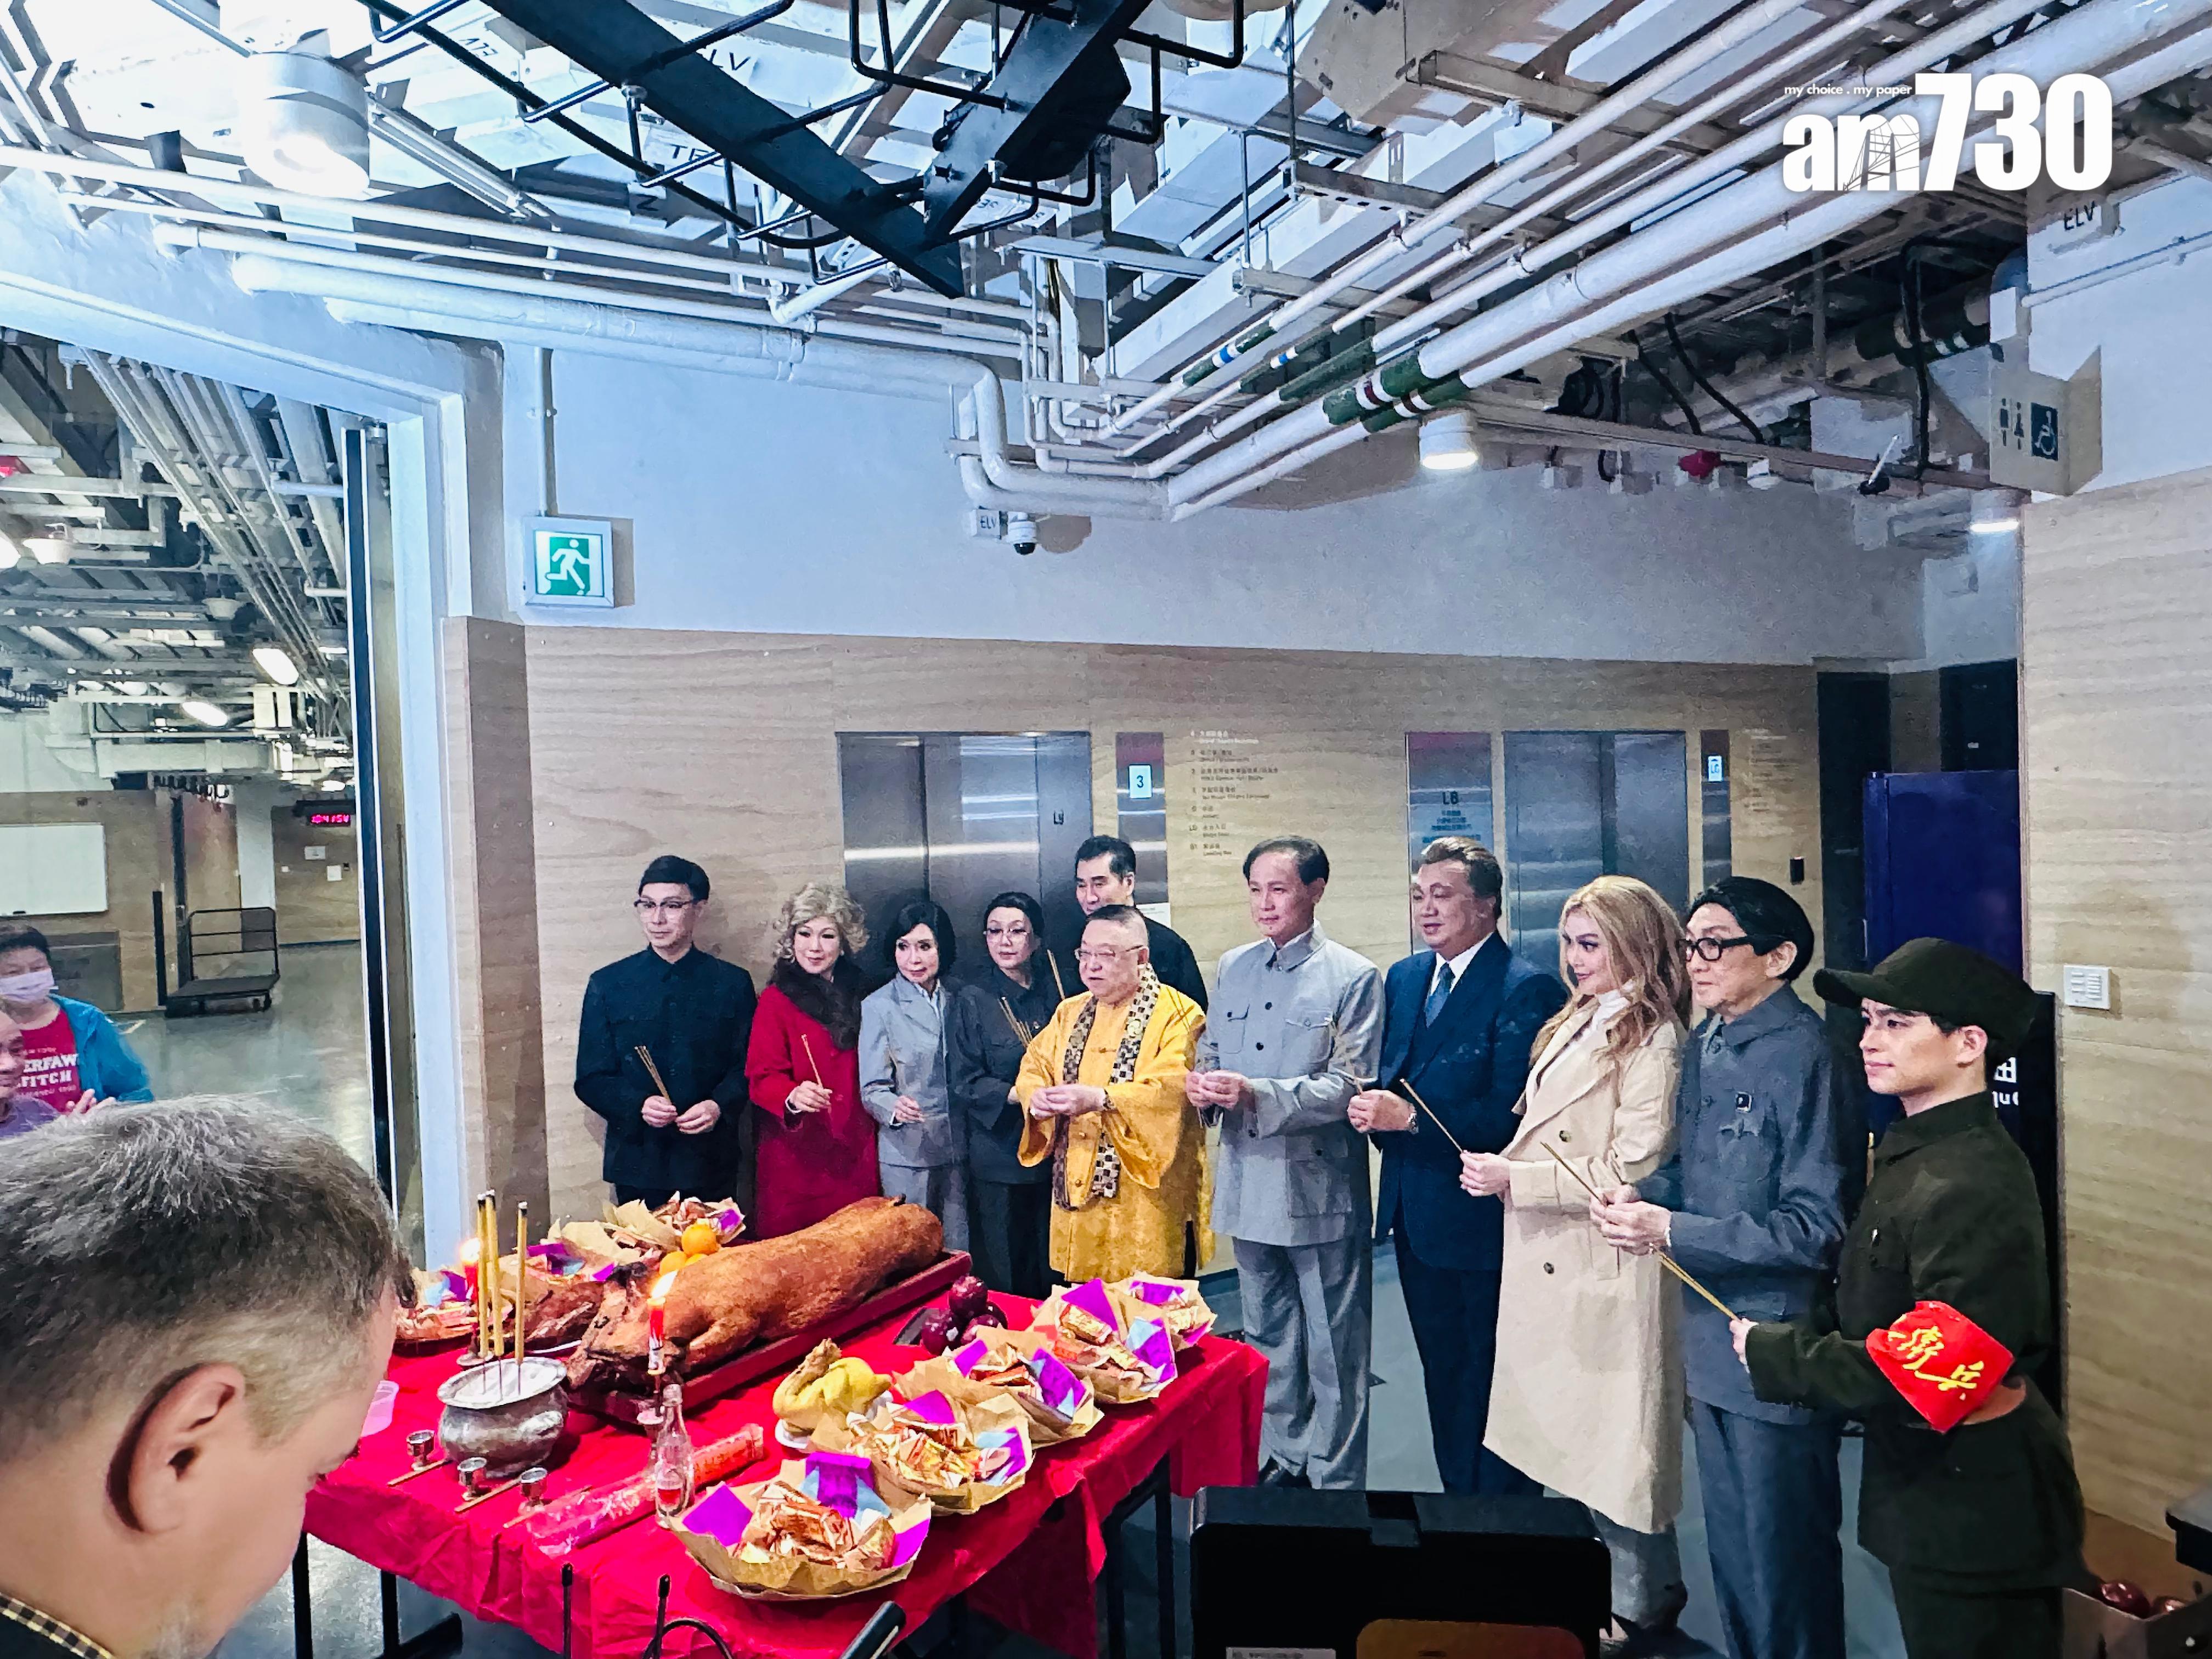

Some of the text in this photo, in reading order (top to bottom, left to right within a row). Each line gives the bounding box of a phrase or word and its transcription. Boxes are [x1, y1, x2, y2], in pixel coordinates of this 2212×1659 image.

[2064, 201, 2095, 230] ELV
[980, 515, 996, 529] ELV
[1136, 775, 1144, 788] 3
